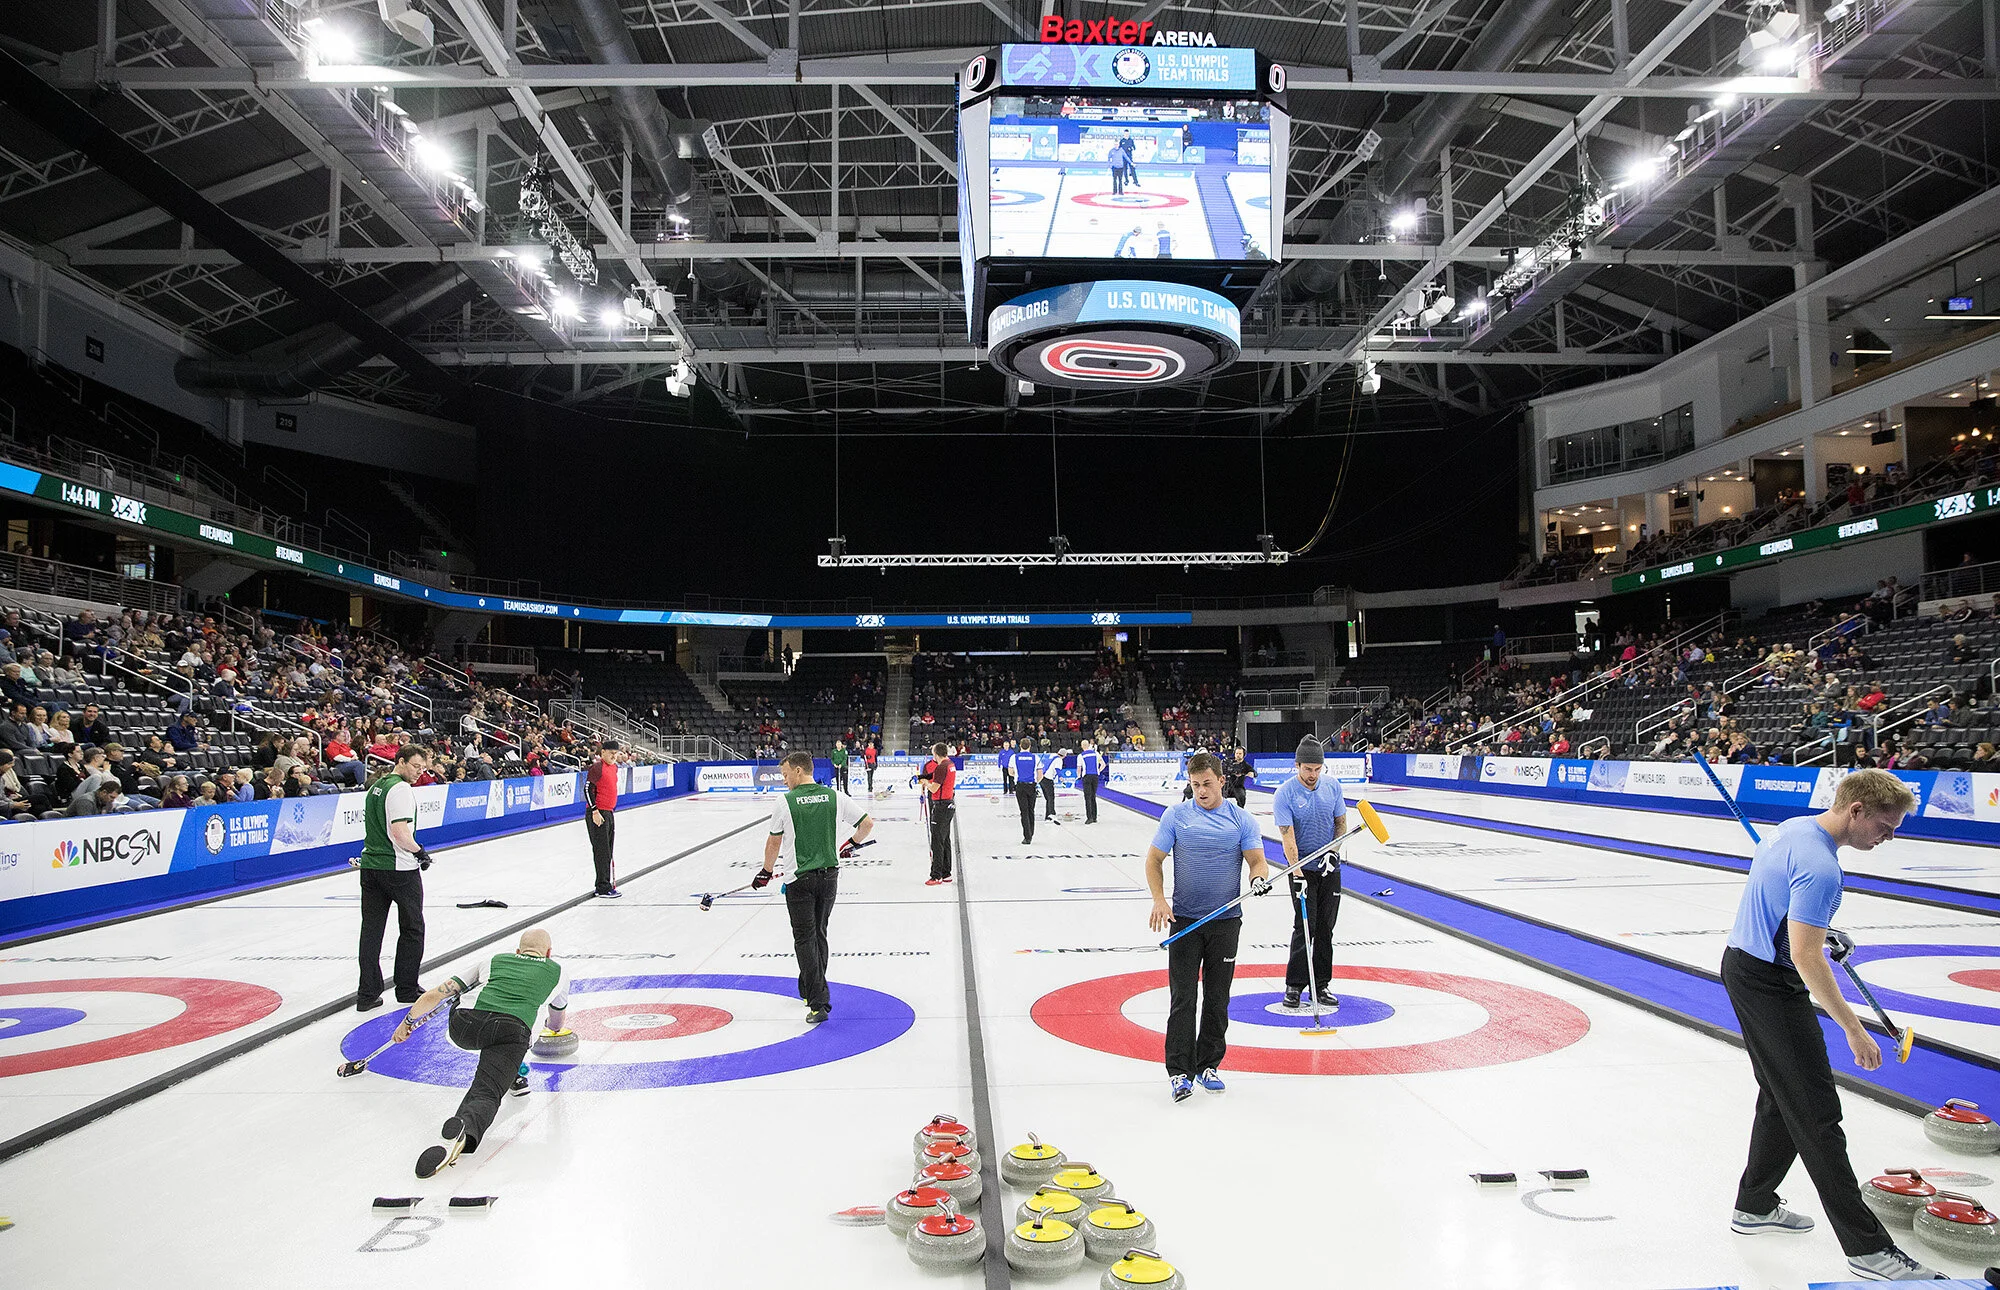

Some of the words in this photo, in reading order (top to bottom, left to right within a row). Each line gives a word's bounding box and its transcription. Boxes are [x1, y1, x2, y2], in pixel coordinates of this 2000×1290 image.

[1040, 15, 1153, 44] Baxter
[1152, 31, 1217, 47] ARENA
[1157, 54, 1179, 67] U.S.
[1181, 54, 1229, 68] OLYMPIC
[1157, 68, 1188, 81] TEAM
[1190, 69, 1229, 82] TRIALS
[1107, 291, 1136, 309] U.S.
[1140, 291, 1199, 315] OLYMPIC
[1201, 299, 1226, 325] TEAM
[991, 299, 1049, 336] EAMUSA.ORG
[62, 482, 83, 505] 1:44
[85, 488, 100, 510] PM
[1838, 518, 1878, 538] #TEAMUSA
[503, 600, 558, 615] TEAMUSASHOP.COM
[947, 616, 959, 625] U.S.
[960, 616, 988, 625] OLYMPIC
[989, 615, 1006, 624] TEAM
[1006, 615, 1030, 624] TRIALS
[1521, 765, 1544, 780] NBCSN
[1755, 779, 1811, 793] TEAMUSASHOP.COM
[796, 794, 829, 805] PERSINGER
[229, 817, 243, 832] U.S.
[243, 814, 269, 830] OLYMPIC
[230, 831, 247, 847] TEAM
[247, 829, 269, 845] TRIALS
[83, 829, 160, 866] NBCSN
[1520, 1188, 1616, 1222] C
[356, 1216, 445, 1252] B
